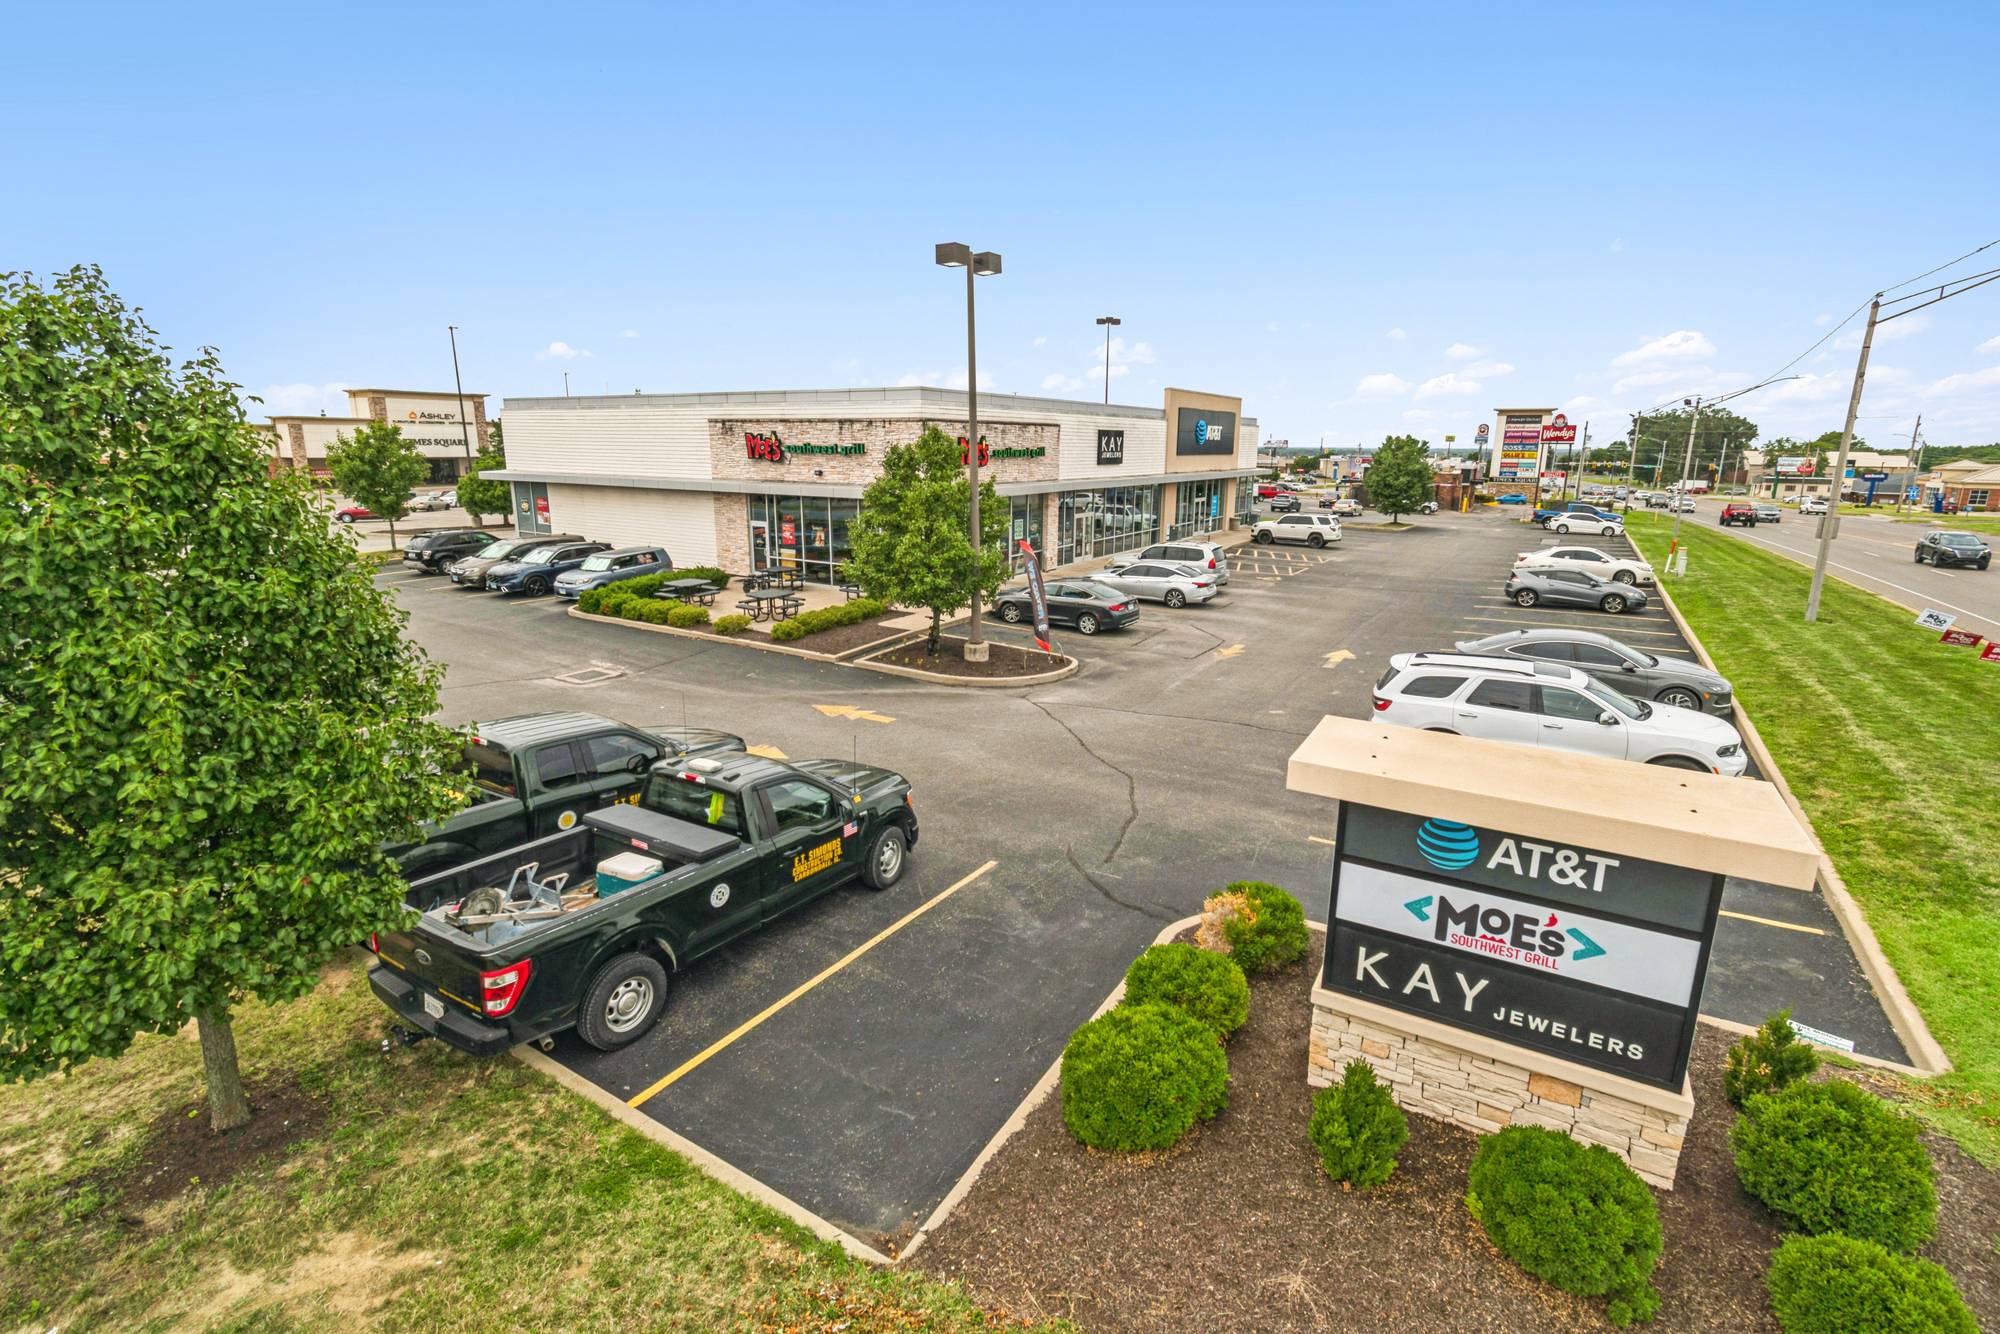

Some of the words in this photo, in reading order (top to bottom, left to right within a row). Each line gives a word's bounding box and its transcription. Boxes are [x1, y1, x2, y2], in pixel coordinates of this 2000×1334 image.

[1206, 425, 1223, 441] AT&T
[1543, 427, 1575, 440] Wendy's
[784, 443, 839, 456] southwest
[840, 443, 866, 457] grill
[992, 447, 1029, 460] southwest
[1101, 435, 1123, 452] KAY
[808, 838, 841, 861] SIMONDS
[1486, 838, 1620, 892] AT&T
[1435, 896, 1566, 957] MOE'S
[1451, 933, 1520, 960] SOUTHWEST
[1356, 946, 1490, 1012] KAY
[1493, 1006, 1644, 1061] JEWELERS
